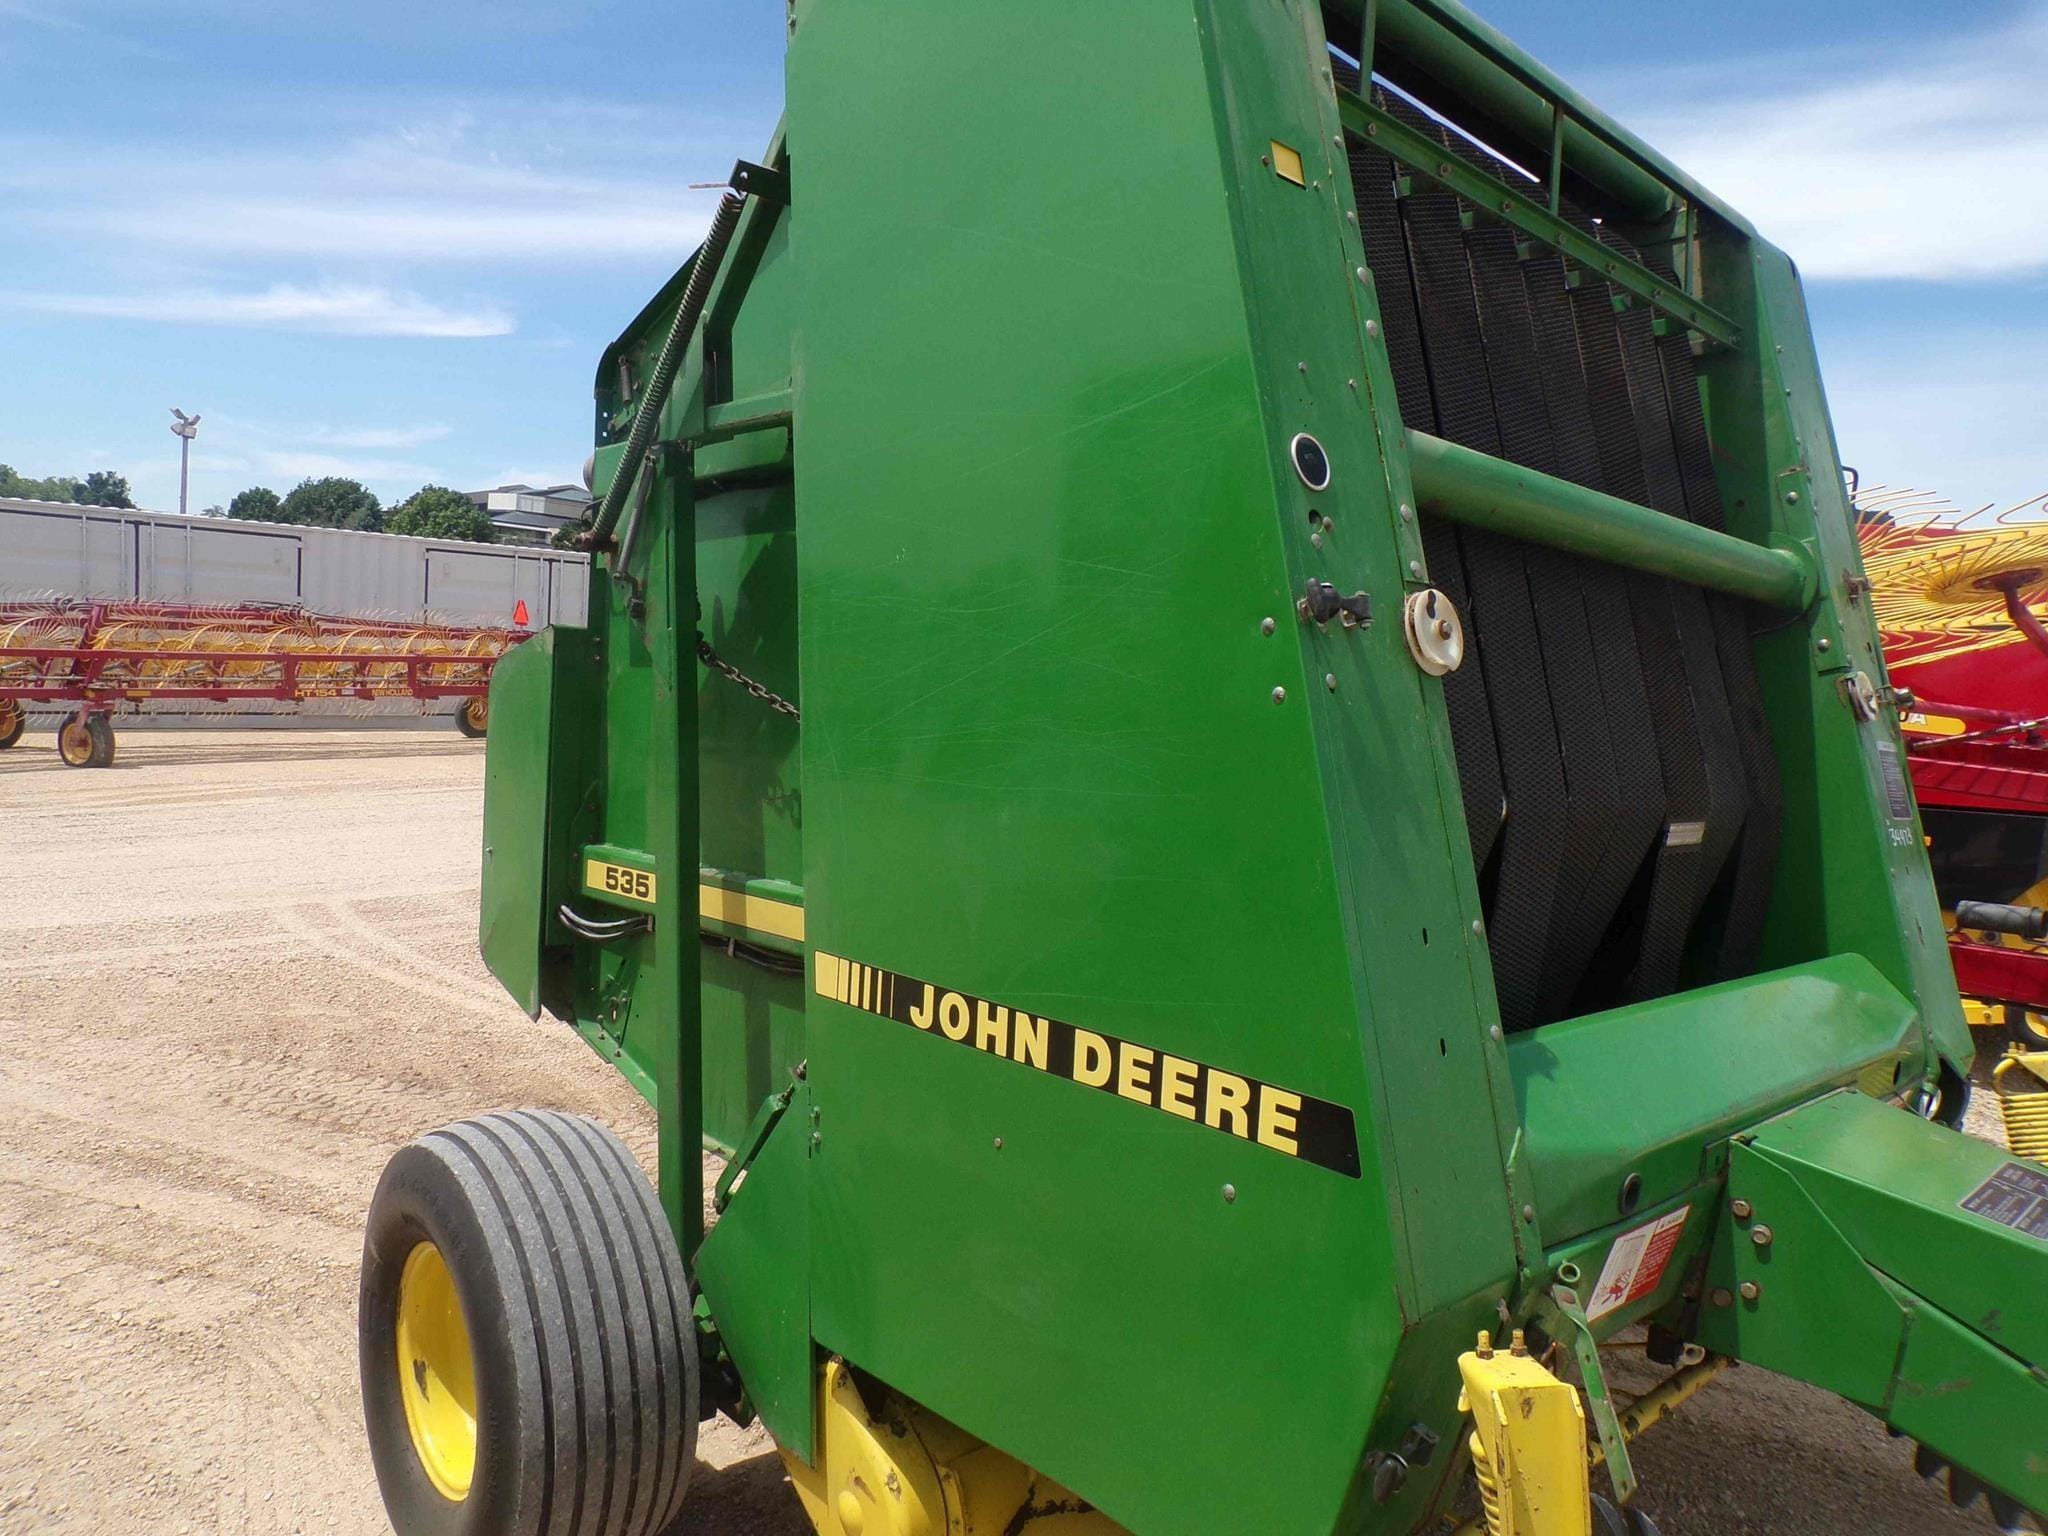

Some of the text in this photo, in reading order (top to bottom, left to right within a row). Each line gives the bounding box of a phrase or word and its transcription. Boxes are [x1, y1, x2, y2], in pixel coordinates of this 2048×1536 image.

[294, 689, 336, 697] HT154
[605, 866, 649, 898] 535
[910, 984, 1302, 1156] JOHN DEERE
